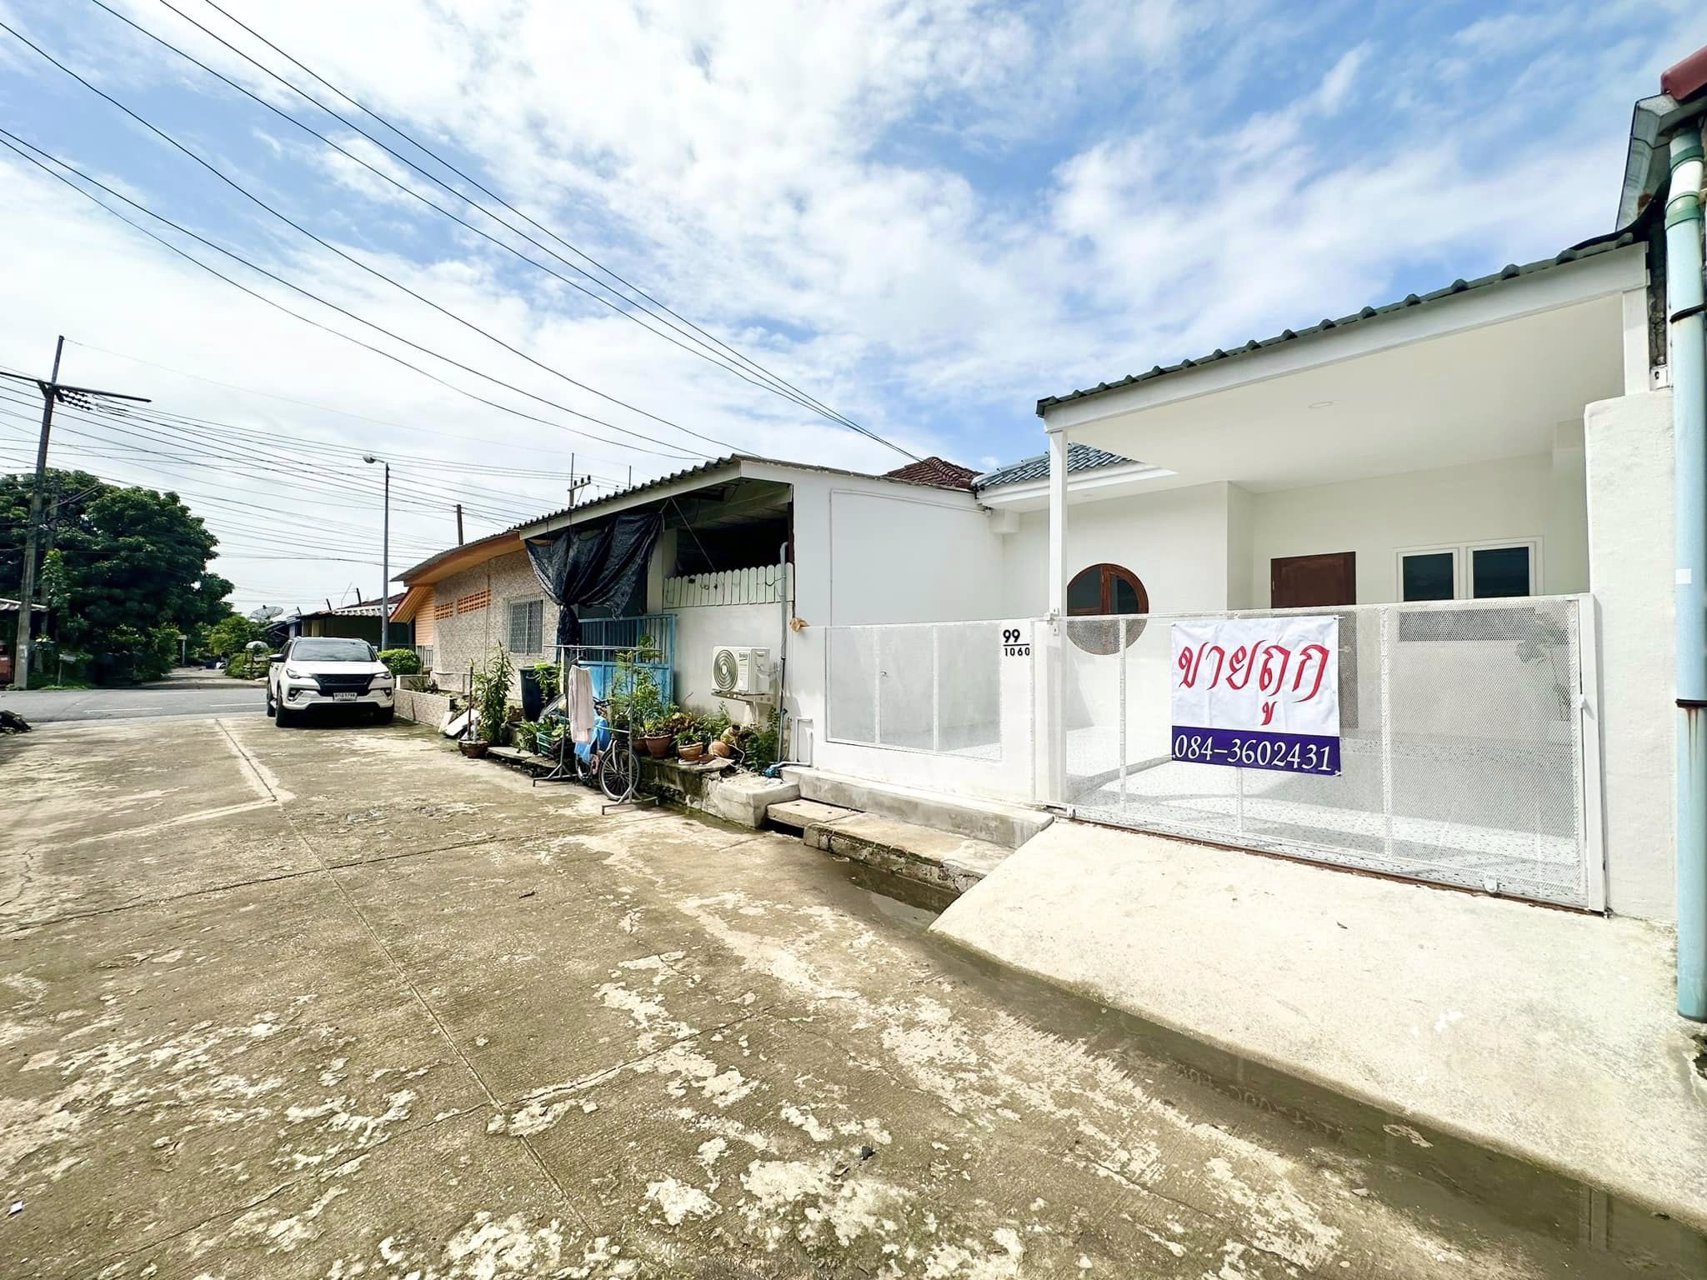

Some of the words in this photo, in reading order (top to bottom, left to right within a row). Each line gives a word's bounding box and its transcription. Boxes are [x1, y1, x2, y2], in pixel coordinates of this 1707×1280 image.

[1003, 629, 1020, 643] 99
[1004, 647, 1031, 656] 1060
[1178, 639, 1330, 726] ขายถูก
[1174, 734, 1332, 771] 084-3602431
